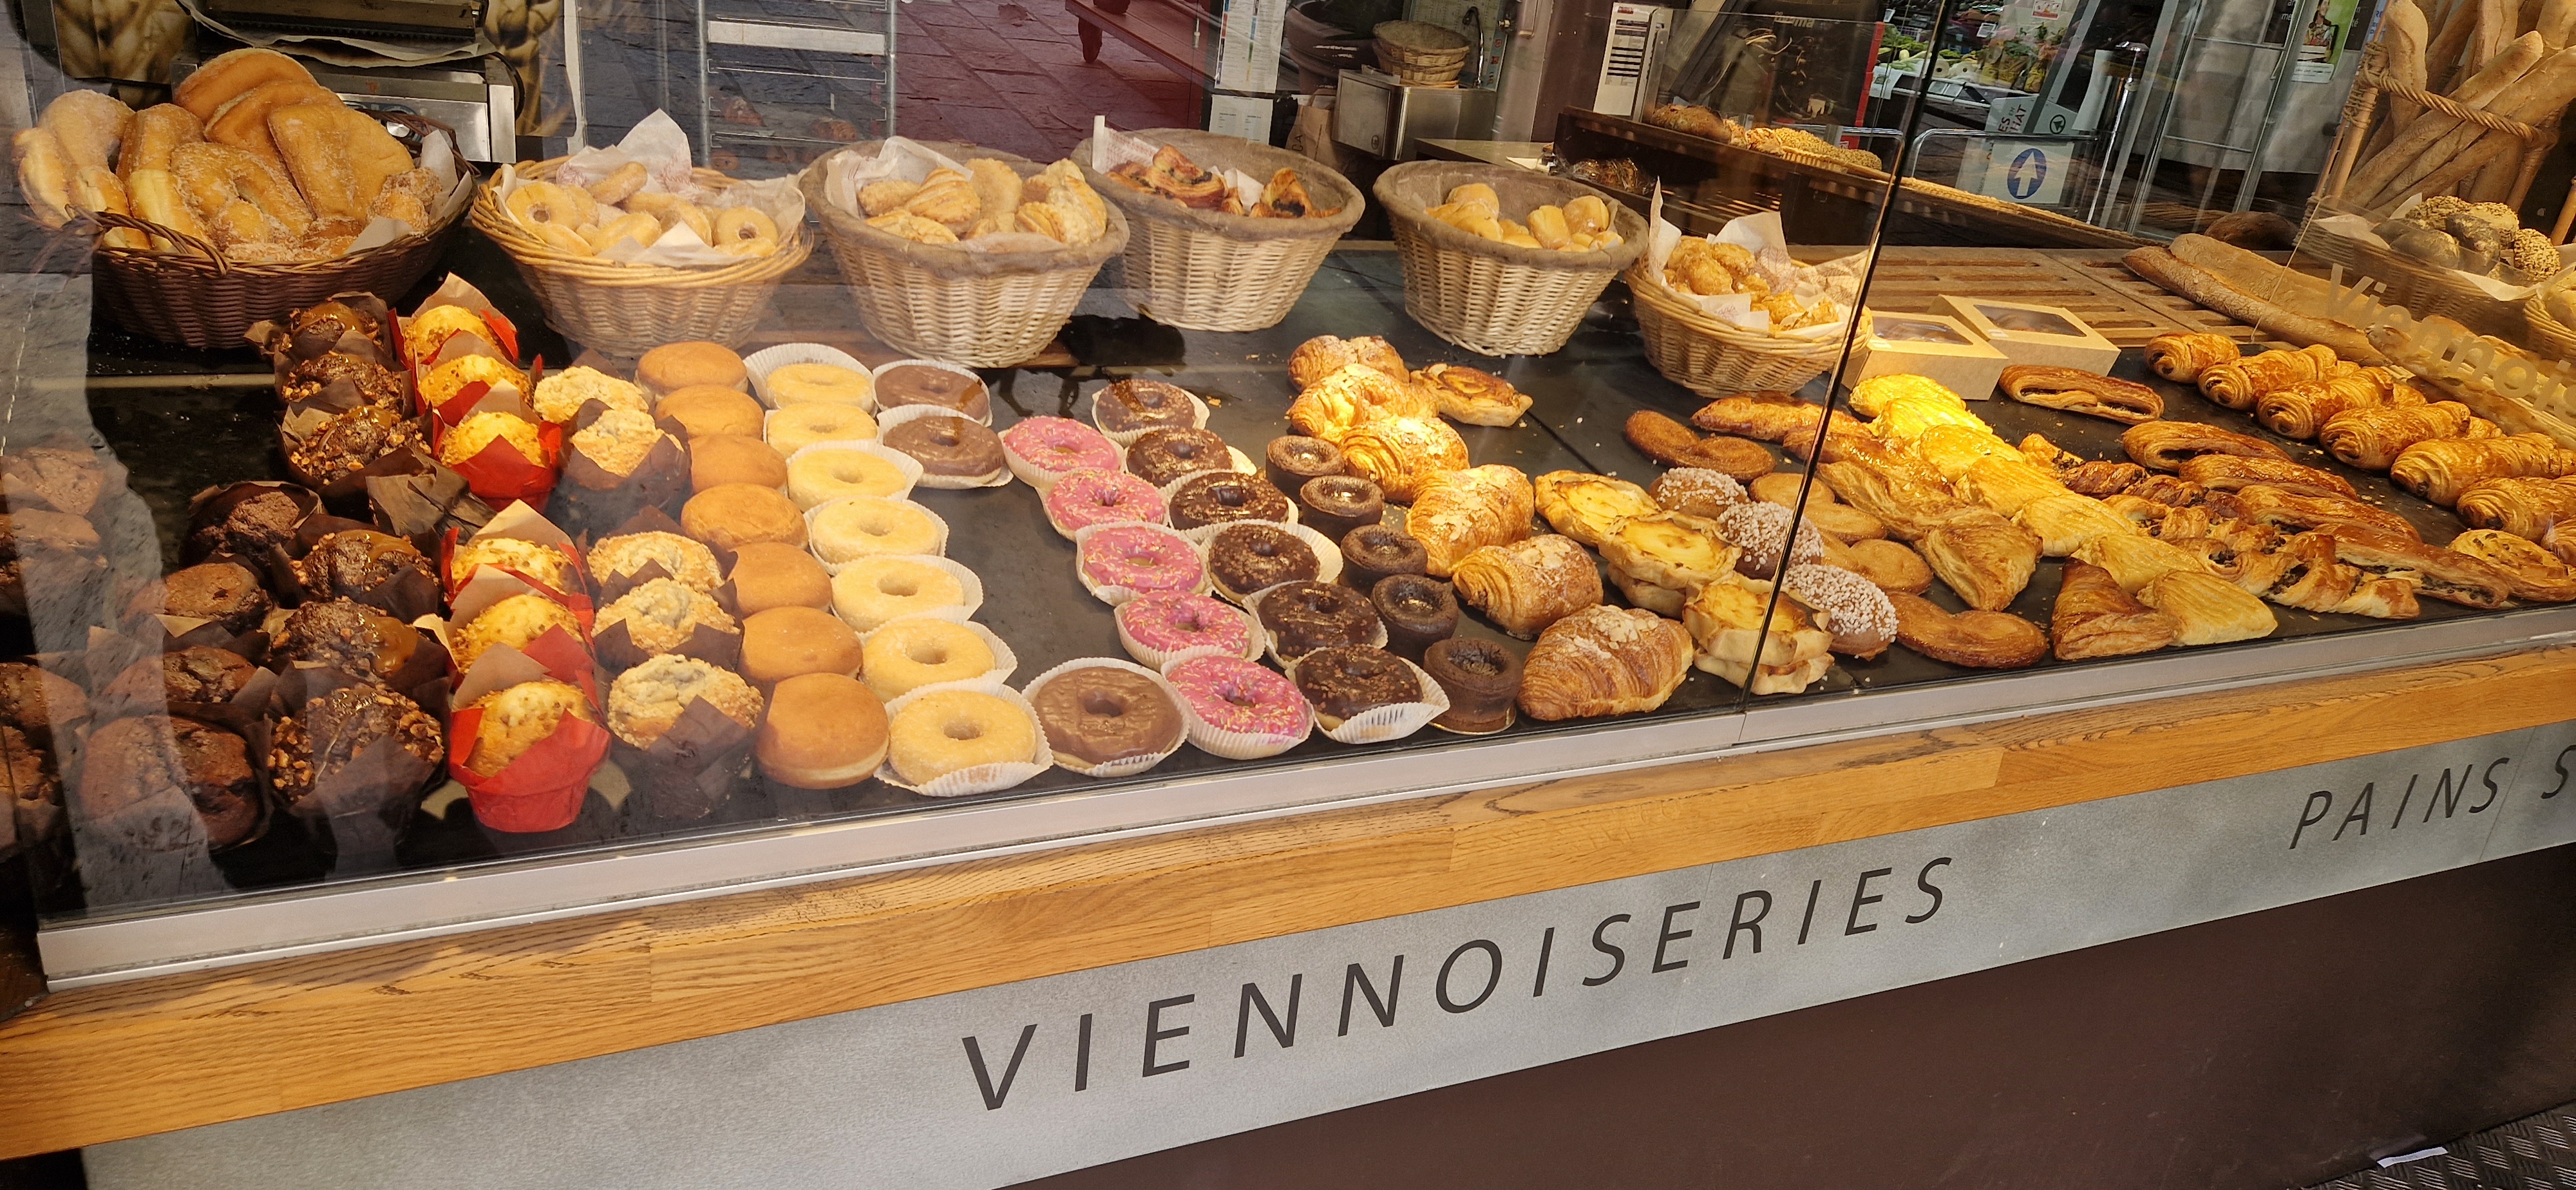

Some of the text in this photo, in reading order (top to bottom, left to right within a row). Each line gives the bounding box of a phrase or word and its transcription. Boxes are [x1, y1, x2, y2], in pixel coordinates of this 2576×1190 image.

[2009, 104, 2027, 132] HAT
[2289, 757, 2511, 850] PAINS
[961, 856, 1953, 1111] VIENNOISERIES
